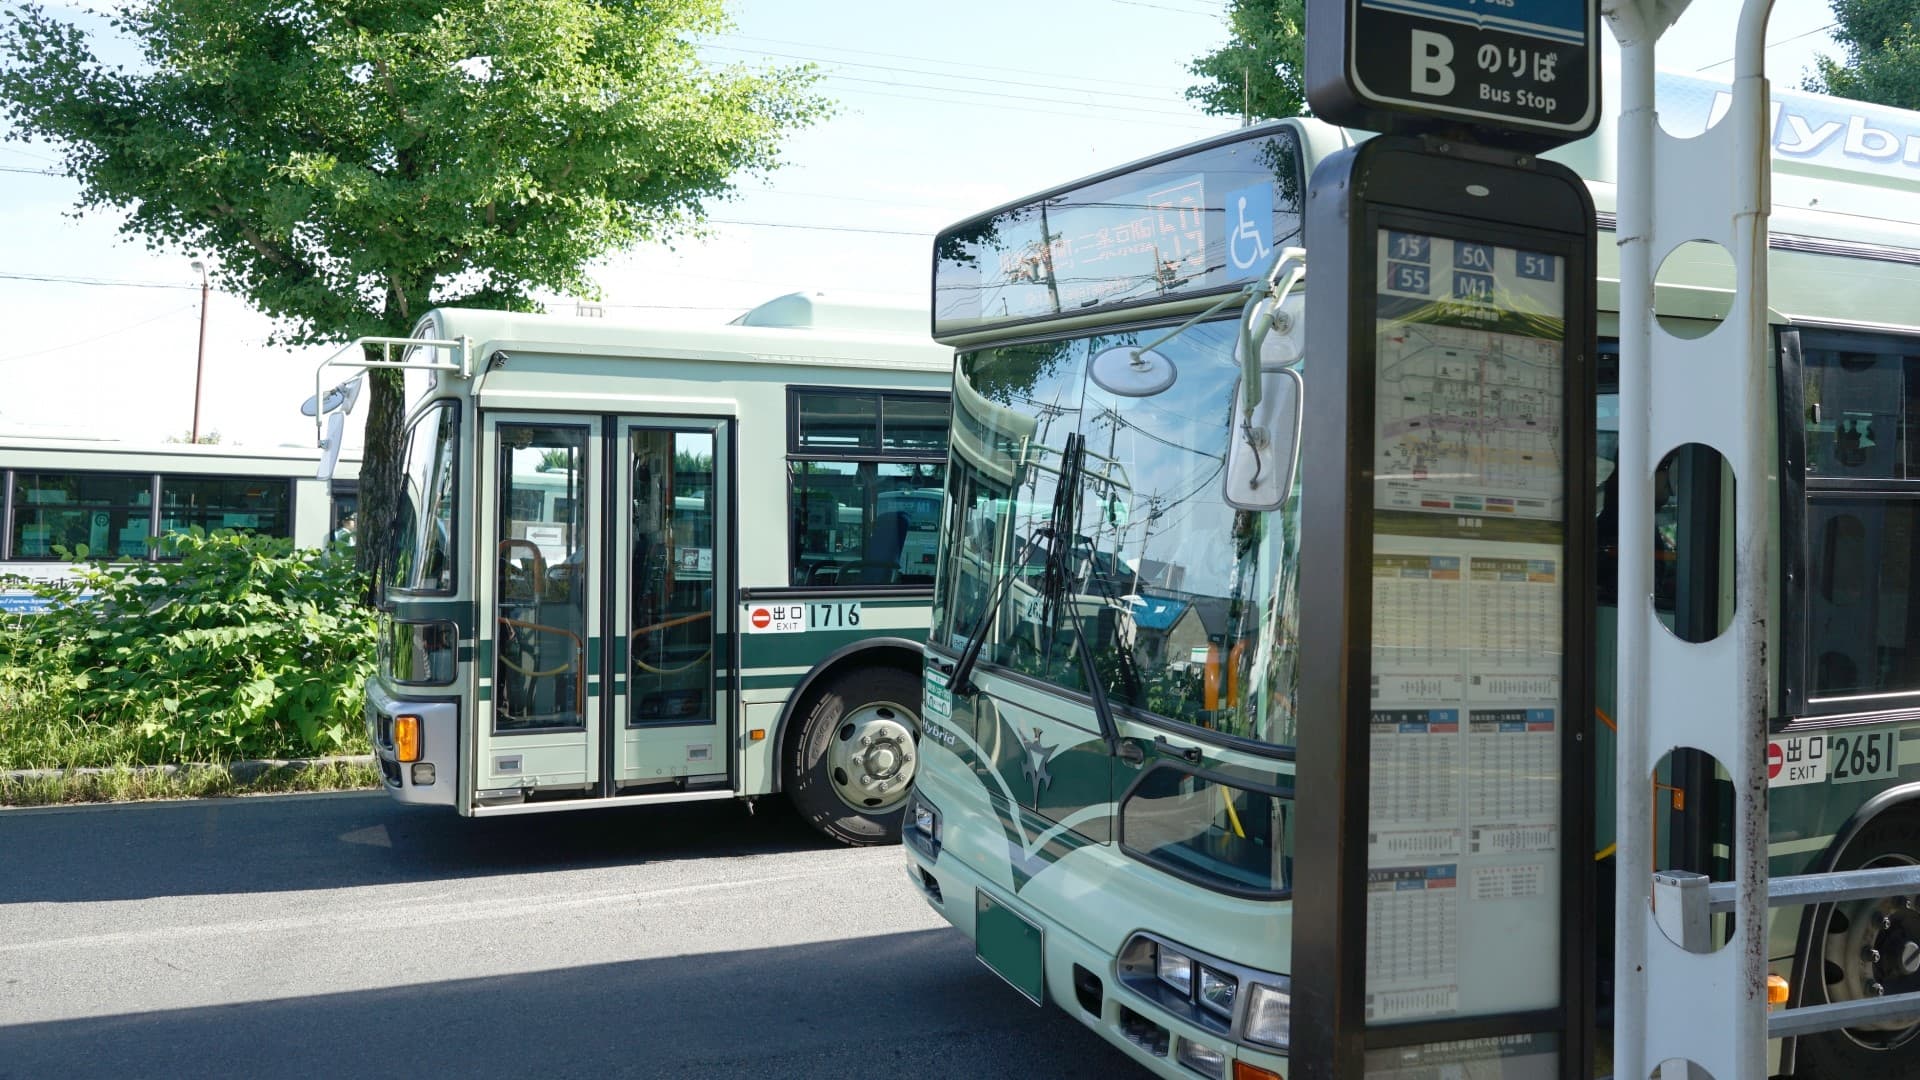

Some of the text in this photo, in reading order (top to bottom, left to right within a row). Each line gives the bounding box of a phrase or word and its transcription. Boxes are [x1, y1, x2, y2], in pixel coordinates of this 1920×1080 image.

[1410, 28, 1456, 97] B
[1477, 43, 1558, 83] のりば
[1479, 83, 1557, 114] Bus Stop
[1397, 238, 1421, 257] 15
[1462, 247, 1486, 267] 50
[1525, 256, 1545, 276] 51
[1401, 268, 1425, 289] 55
[1459, 277, 1487, 298] M1
[773, 606, 802, 620] 出口
[811, 603, 860, 628] 1716
[776, 622, 798, 631] EXIT
[1787, 736, 1823, 763] 出口
[1834, 732, 1893, 779] 2651
[1790, 765, 1817, 780] EXIT
